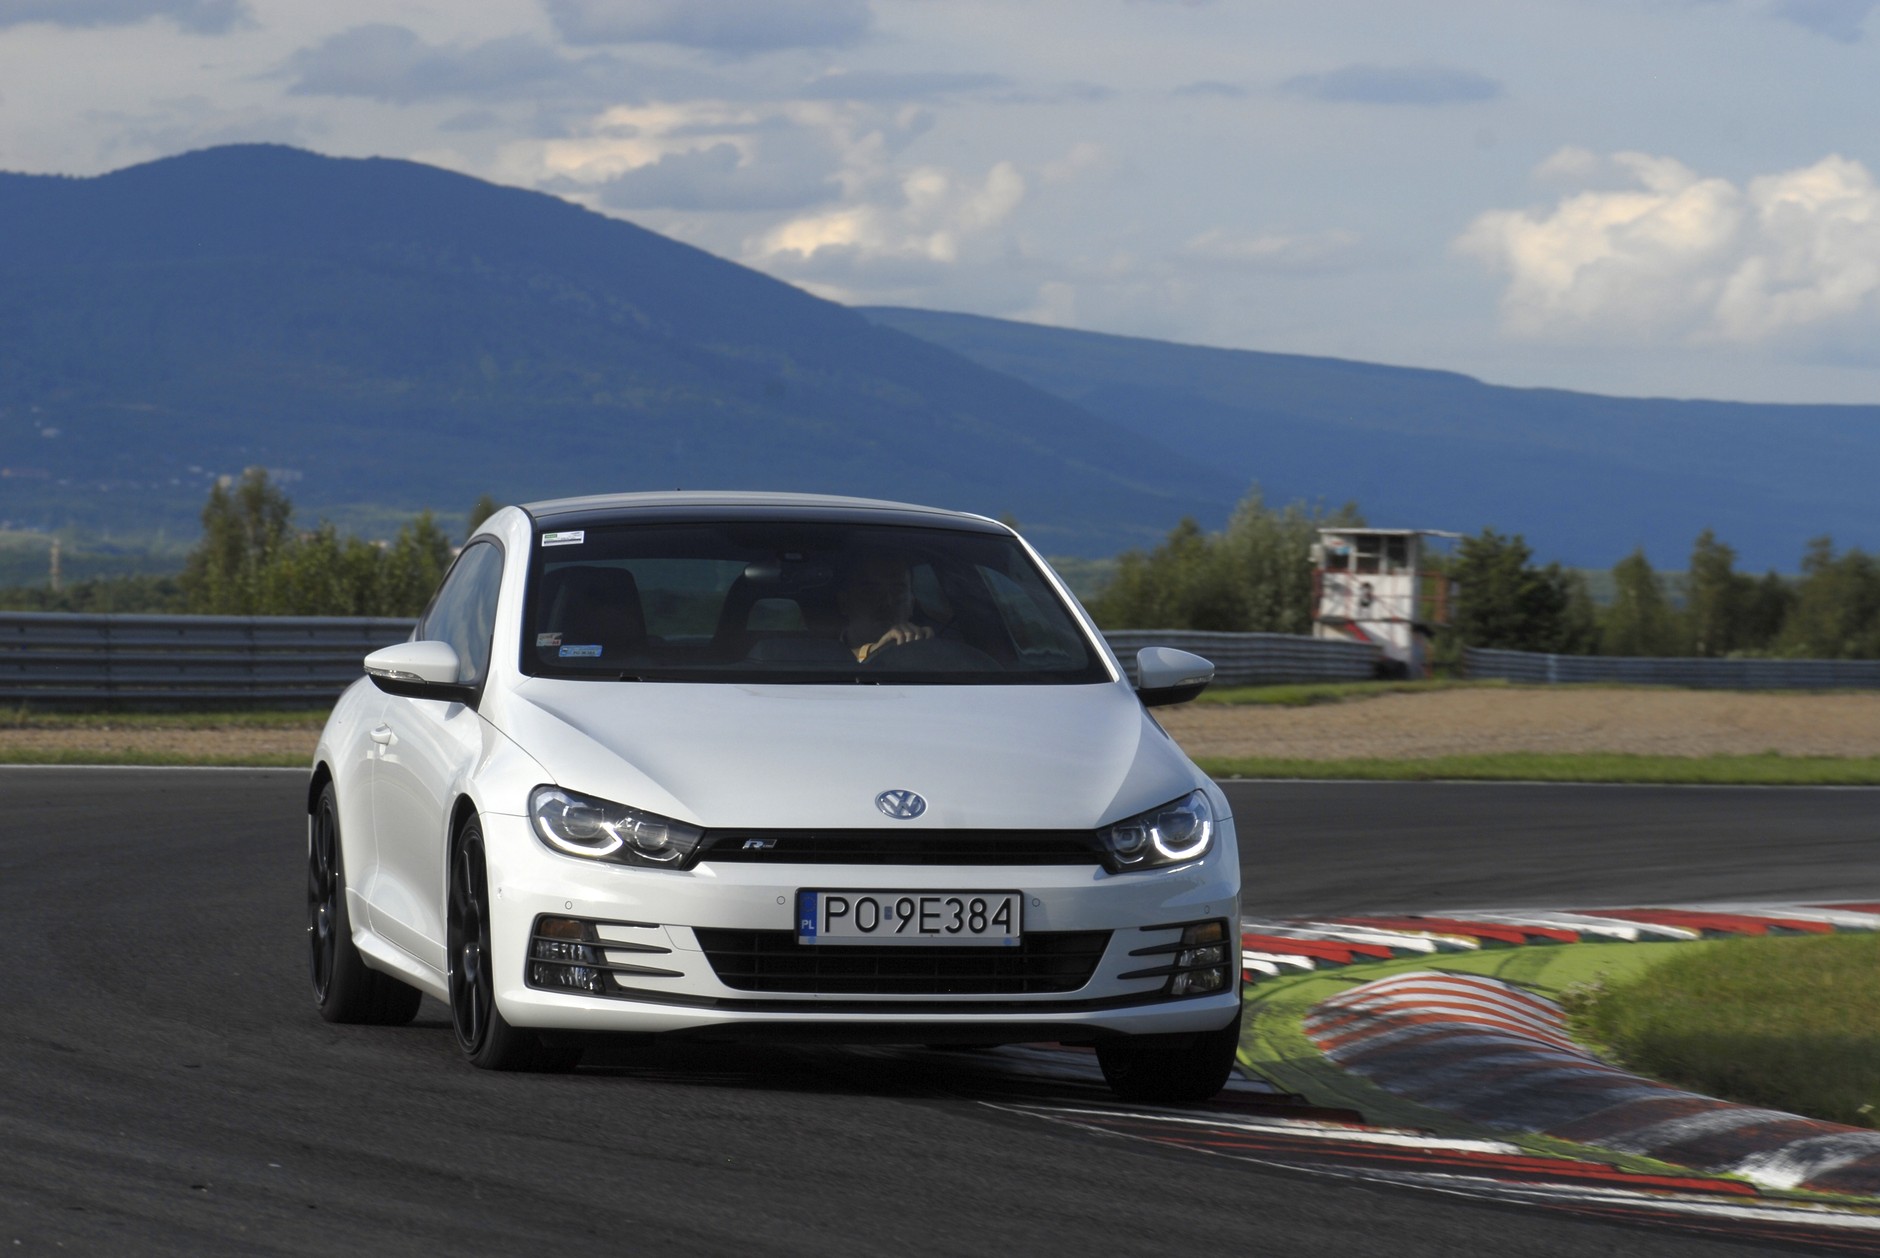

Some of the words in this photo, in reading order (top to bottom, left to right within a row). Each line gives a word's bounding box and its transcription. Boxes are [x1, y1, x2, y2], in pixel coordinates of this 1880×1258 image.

[801, 919, 815, 930] PL
[824, 896, 880, 933] PO
[894, 896, 1012, 934] 9E384
